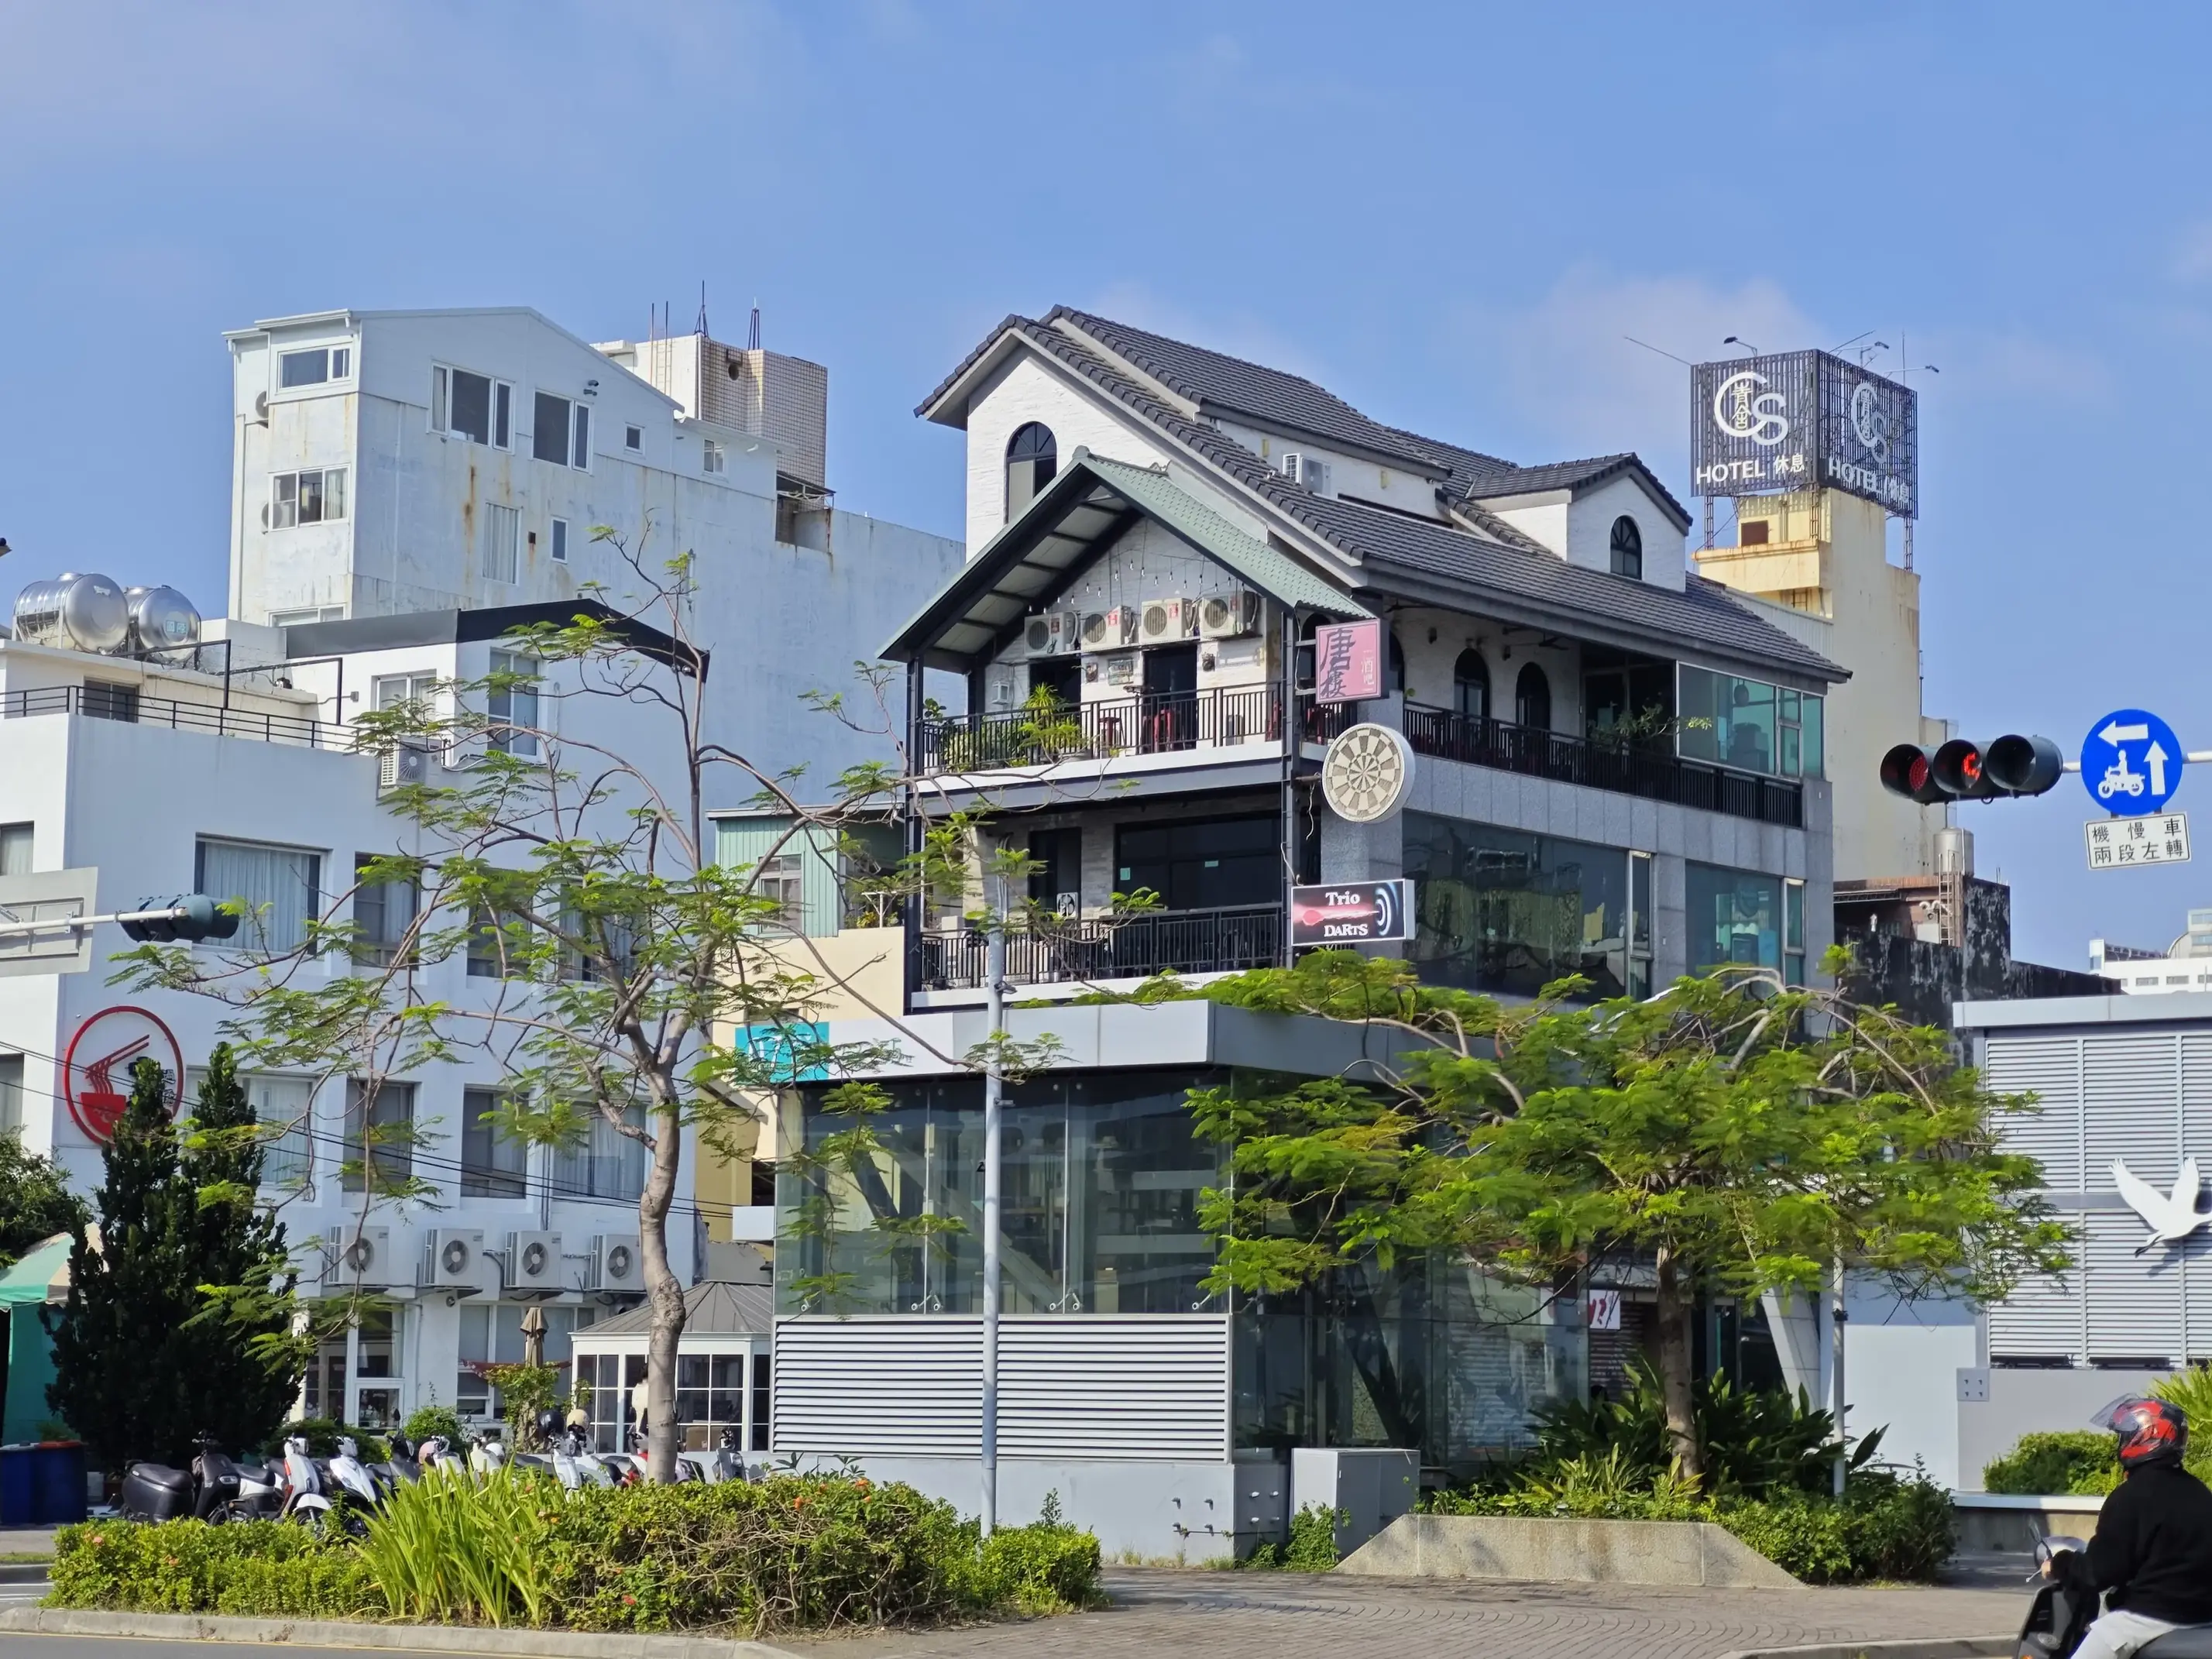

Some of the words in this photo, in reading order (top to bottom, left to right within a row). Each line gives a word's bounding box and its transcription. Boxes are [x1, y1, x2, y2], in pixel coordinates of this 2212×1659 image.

[1696, 459, 1766, 485] HOTEL
[1774, 452, 1805, 475] 休息
[1829, 457, 1882, 494] HOTEL
[2092, 818, 2181, 843] 機慢車
[2094, 839, 2184, 864] 兩段左轉
[1325, 891, 1361, 906] Trio
[1324, 924, 1369, 937] DARTS
